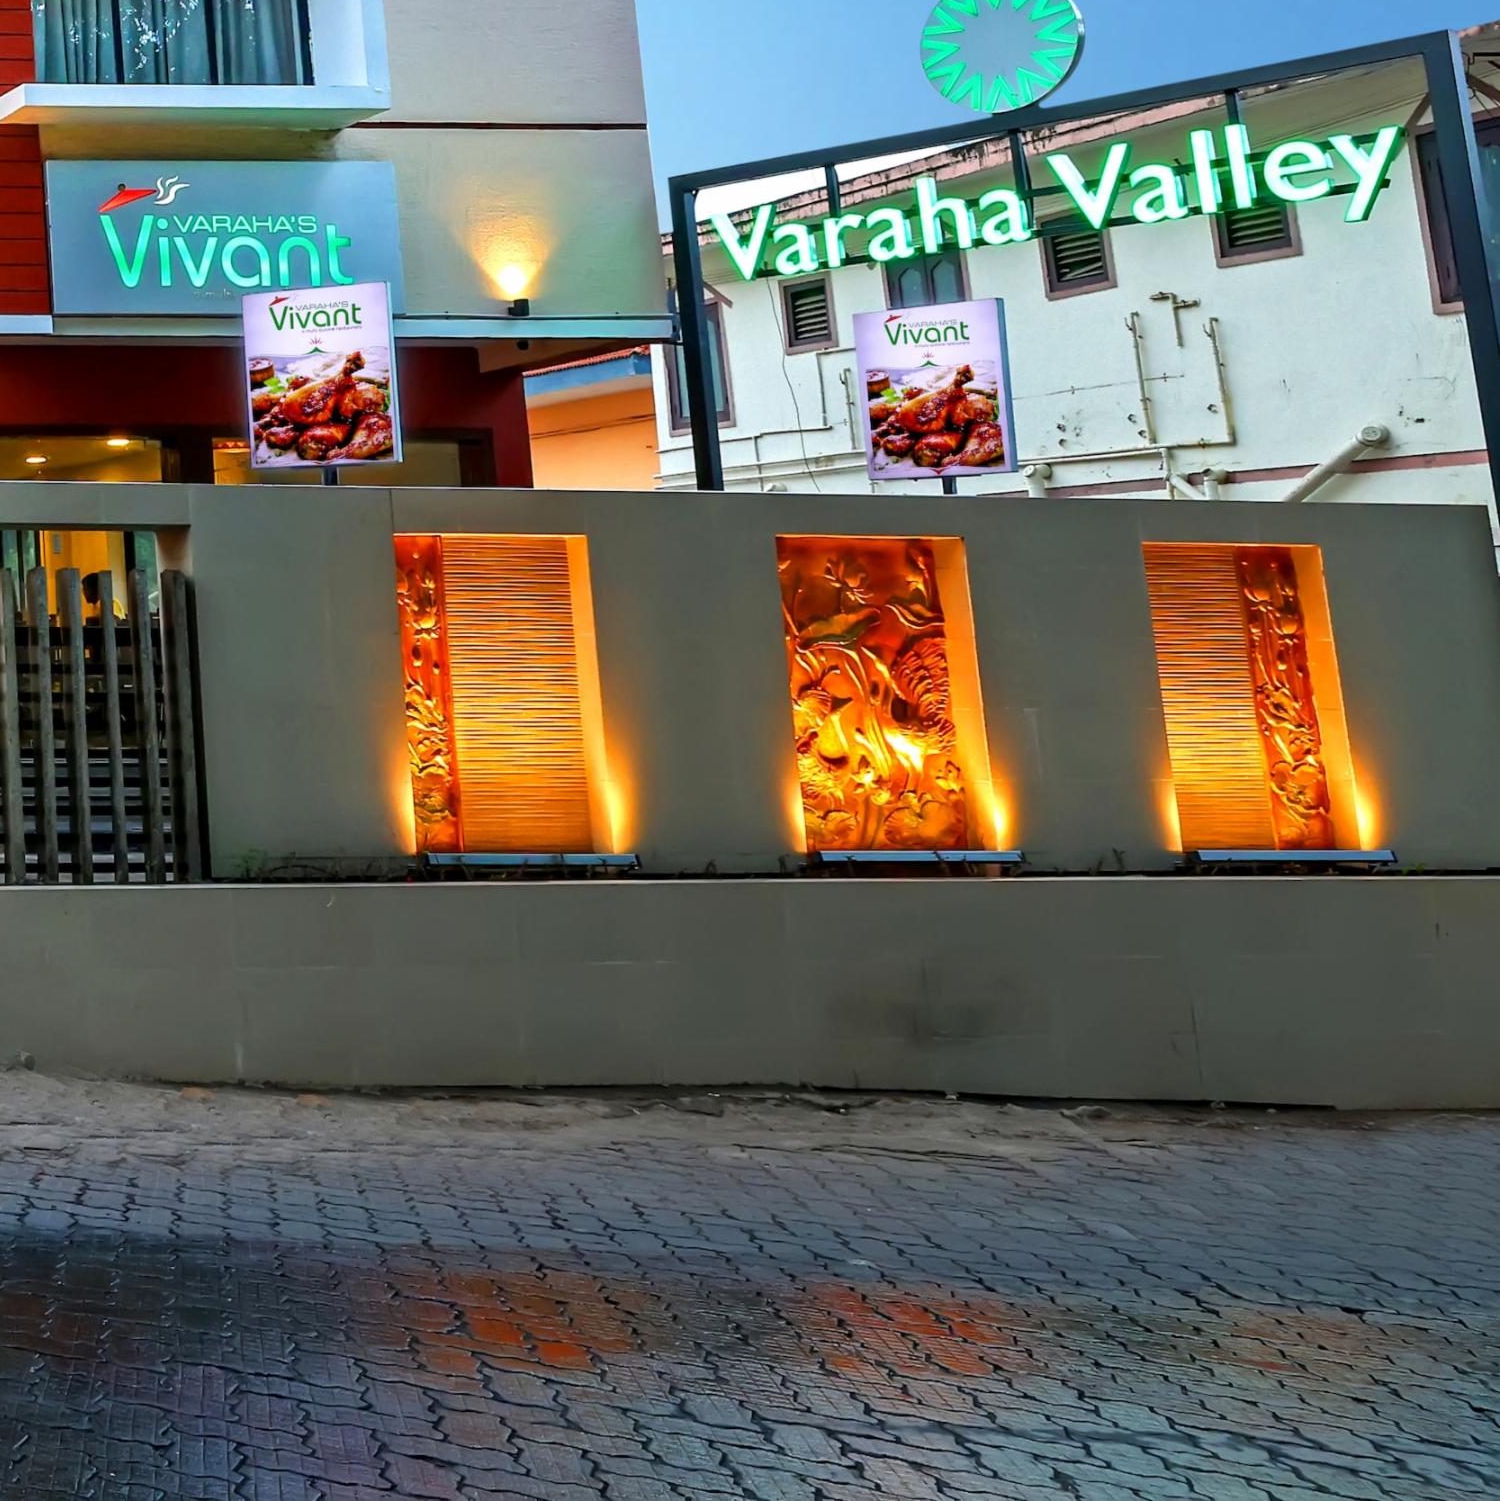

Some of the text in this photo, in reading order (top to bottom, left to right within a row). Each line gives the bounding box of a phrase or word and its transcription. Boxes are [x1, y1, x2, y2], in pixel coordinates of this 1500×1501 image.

[709, 123, 1404, 282] Varaha Valley
[171, 214, 317, 234] VARAHA'S
[100, 214, 355, 289] Vivant
[268, 302, 362, 331] Vivant
[883, 321, 970, 346] Vivant
